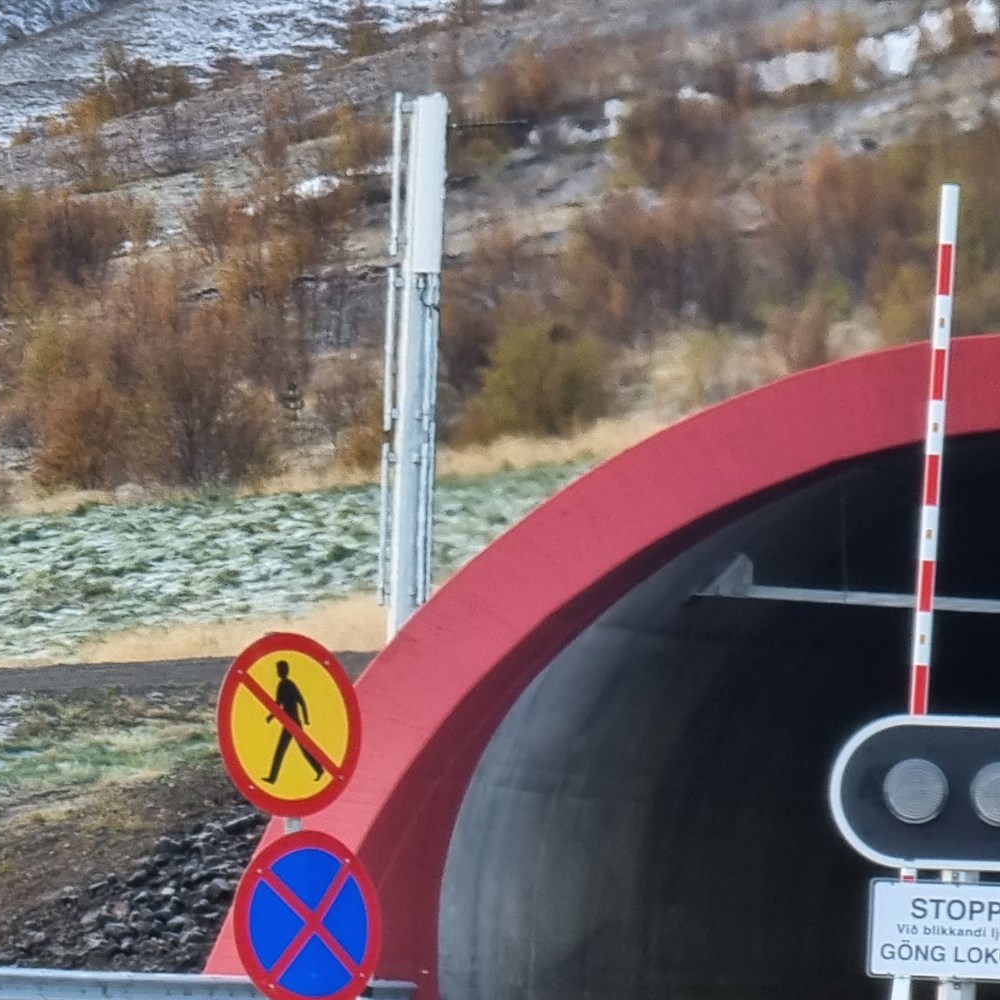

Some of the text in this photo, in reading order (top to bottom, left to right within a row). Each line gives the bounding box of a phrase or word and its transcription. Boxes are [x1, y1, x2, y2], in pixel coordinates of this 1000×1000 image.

[910, 897, 1000, 921] STOPP
[896, 923, 919, 936] Við
[923, 925, 987, 938] blikkandi
[880, 939, 1000, 964] GÖNG LOK
